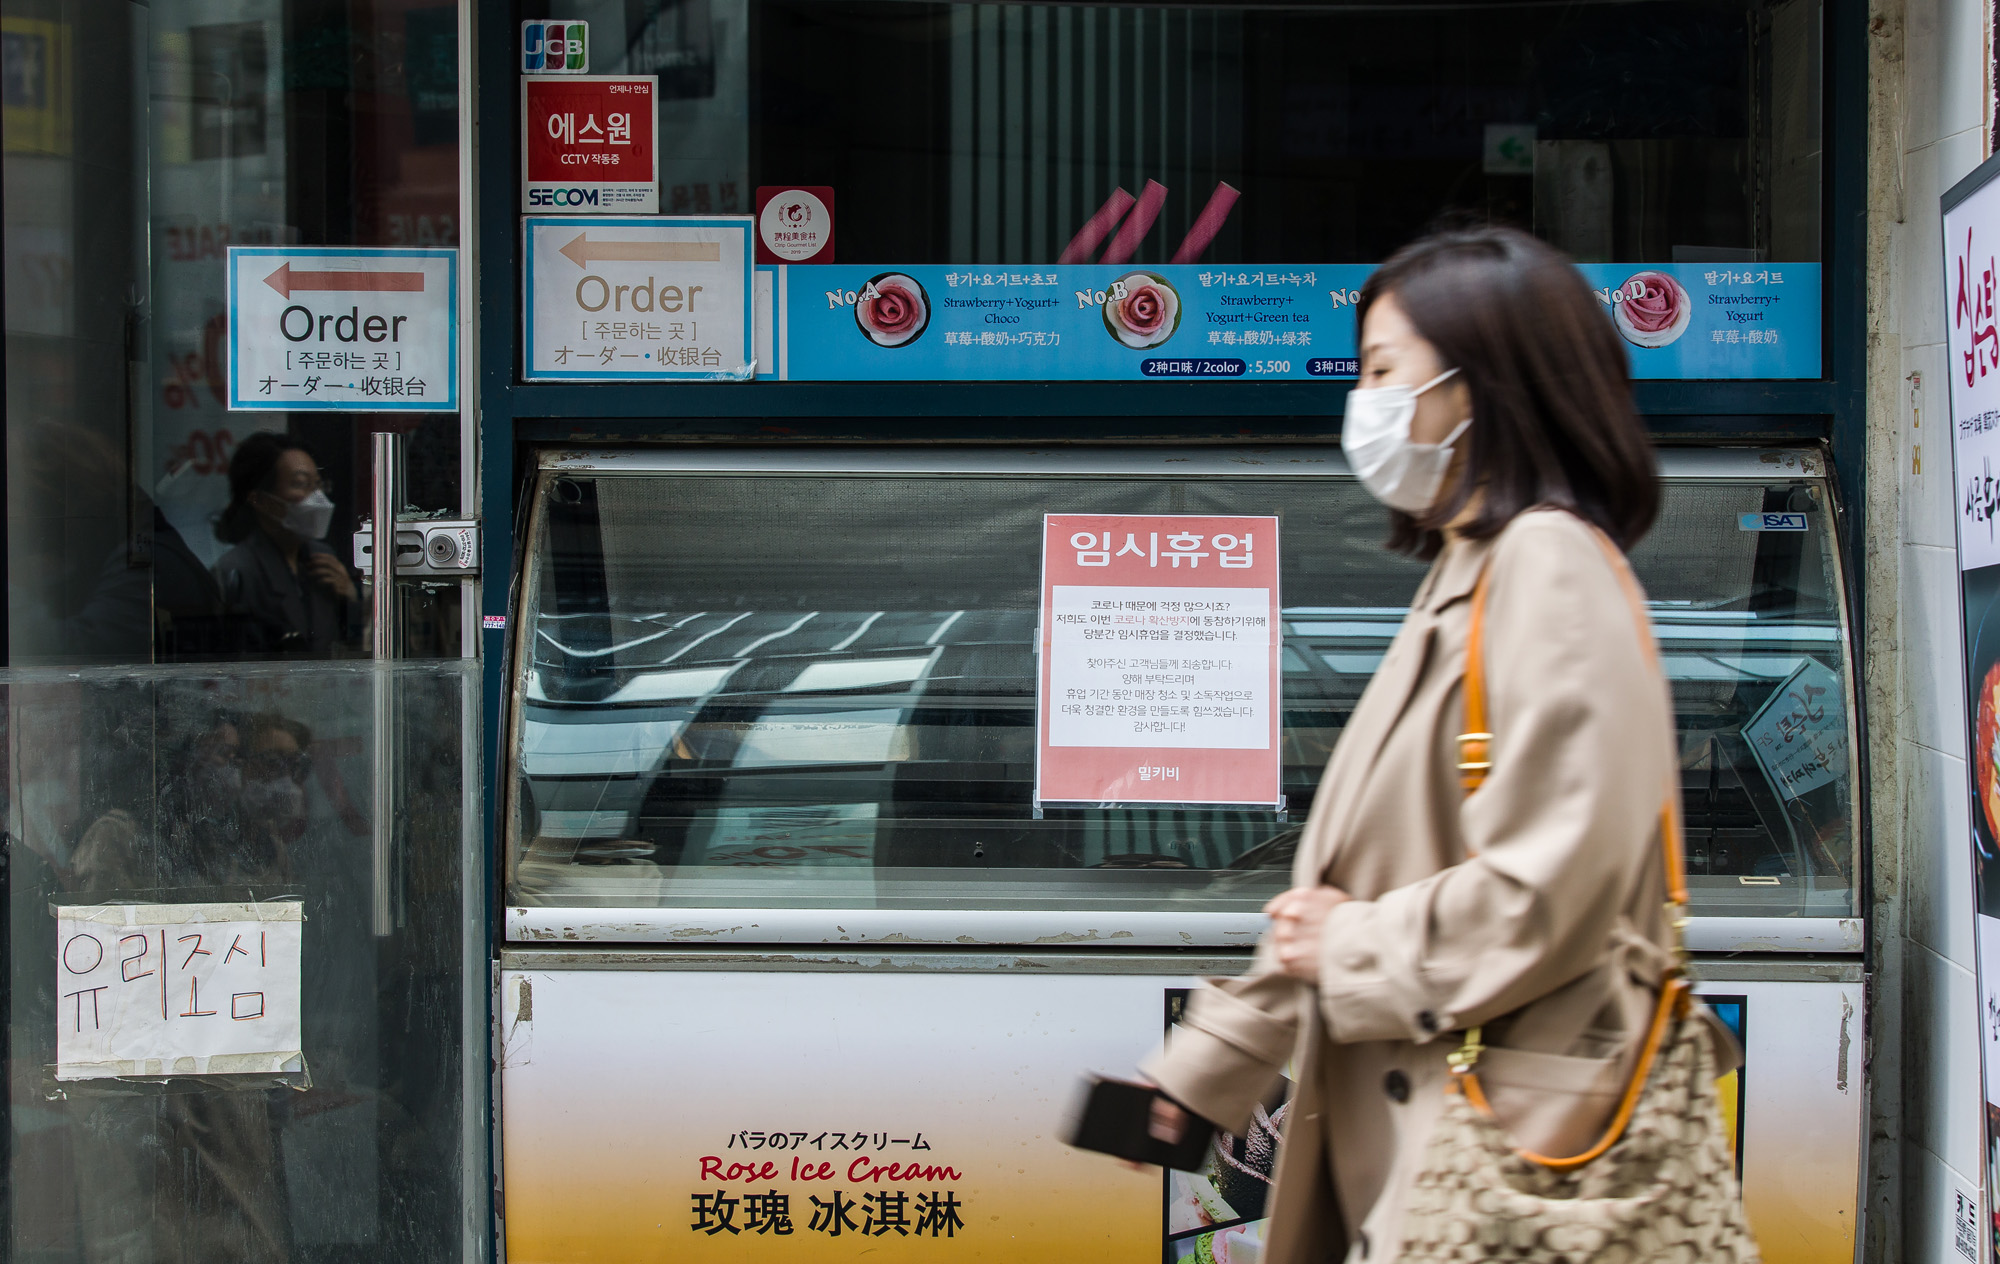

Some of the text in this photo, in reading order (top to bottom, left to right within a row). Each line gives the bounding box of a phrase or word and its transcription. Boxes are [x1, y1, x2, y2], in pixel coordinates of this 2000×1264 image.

[525, 39, 584, 55] JCB
[609, 85, 649, 94] 언제나 안심
[547, 113, 631, 145] 에스원
[560, 154, 620, 165] CCTV 작동중
[528, 188, 599, 207] SECOM
[945, 272, 1059, 287] 딸기+요거트+초코
[1198, 271, 1318, 287] 딸기+요거트+녹차
[1704, 270, 1784, 286] 딸기+요거트
[575, 275, 703, 313] Order
[825, 281, 882, 310] No.A
[1074, 280, 1130, 310] No.B
[1220, 294, 1294, 307] Strawberry+
[1592, 280, 1647, 306] No.D
[1708, 294, 1781, 307] Strawberry+
[943, 297, 1060, 310] Strawberry+Yogurt+
[280, 304, 408, 343] Order
[984, 313, 1020, 325] Choco
[1206, 312, 1310, 324] Yogurt+Green tea
[1726, 310, 1764, 323] Yogurt
[594, 322, 663, 341] 주문하는
[667, 322, 685, 341] 곳
[944, 331, 1060, 347] 草莓+酸奶+巧克力
[1207, 331, 1312, 346] 草莓+酸奶+绿茶
[1711, 330, 1778, 345] 草莓+酸奶
[298, 351, 367, 370] 주문하는
[372, 352, 389, 371] 곳
[1148, 360, 1194, 374] 2种口味
[1203, 361, 1240, 373] 2color
[1255, 360, 1291, 375] 5,500
[1763, 514, 1793, 526] ISA
[1070, 531, 1254, 569] 임시휴업
[1091, 600, 1231, 612] 코로나 때문에 걱정 많으시죠?
[1056, 614, 1266, 627] 저희도 이번 코로나 확산방지에 동참하기위해
[1083, 628, 1238, 641] 당분간 임시휴업을 결정했습니다.
[1086, 658, 1233, 670] 찾아주신 고객님들께 죄송합니다.
[1122, 674, 1195, 685] 양해 부탁드리며
[1066, 688, 1254, 701] 휴업 기간 동안 매장 청소 및 소독작업으로
[1061, 704, 1255, 717] 더욱 청결한 환경을 만들도록 힘쓰겠습니다.
[1133, 721, 1186, 733] 감사합니다!
[1138, 766, 1180, 781] 밀키비
[63, 929, 266, 1033] 유리조심
[727, 1130, 932, 1151] バラのアイスクリーム
[699, 1156, 962, 1183] Rose Ice Cream
[690, 1189, 966, 1238] 玫瑰 冰淇淋
